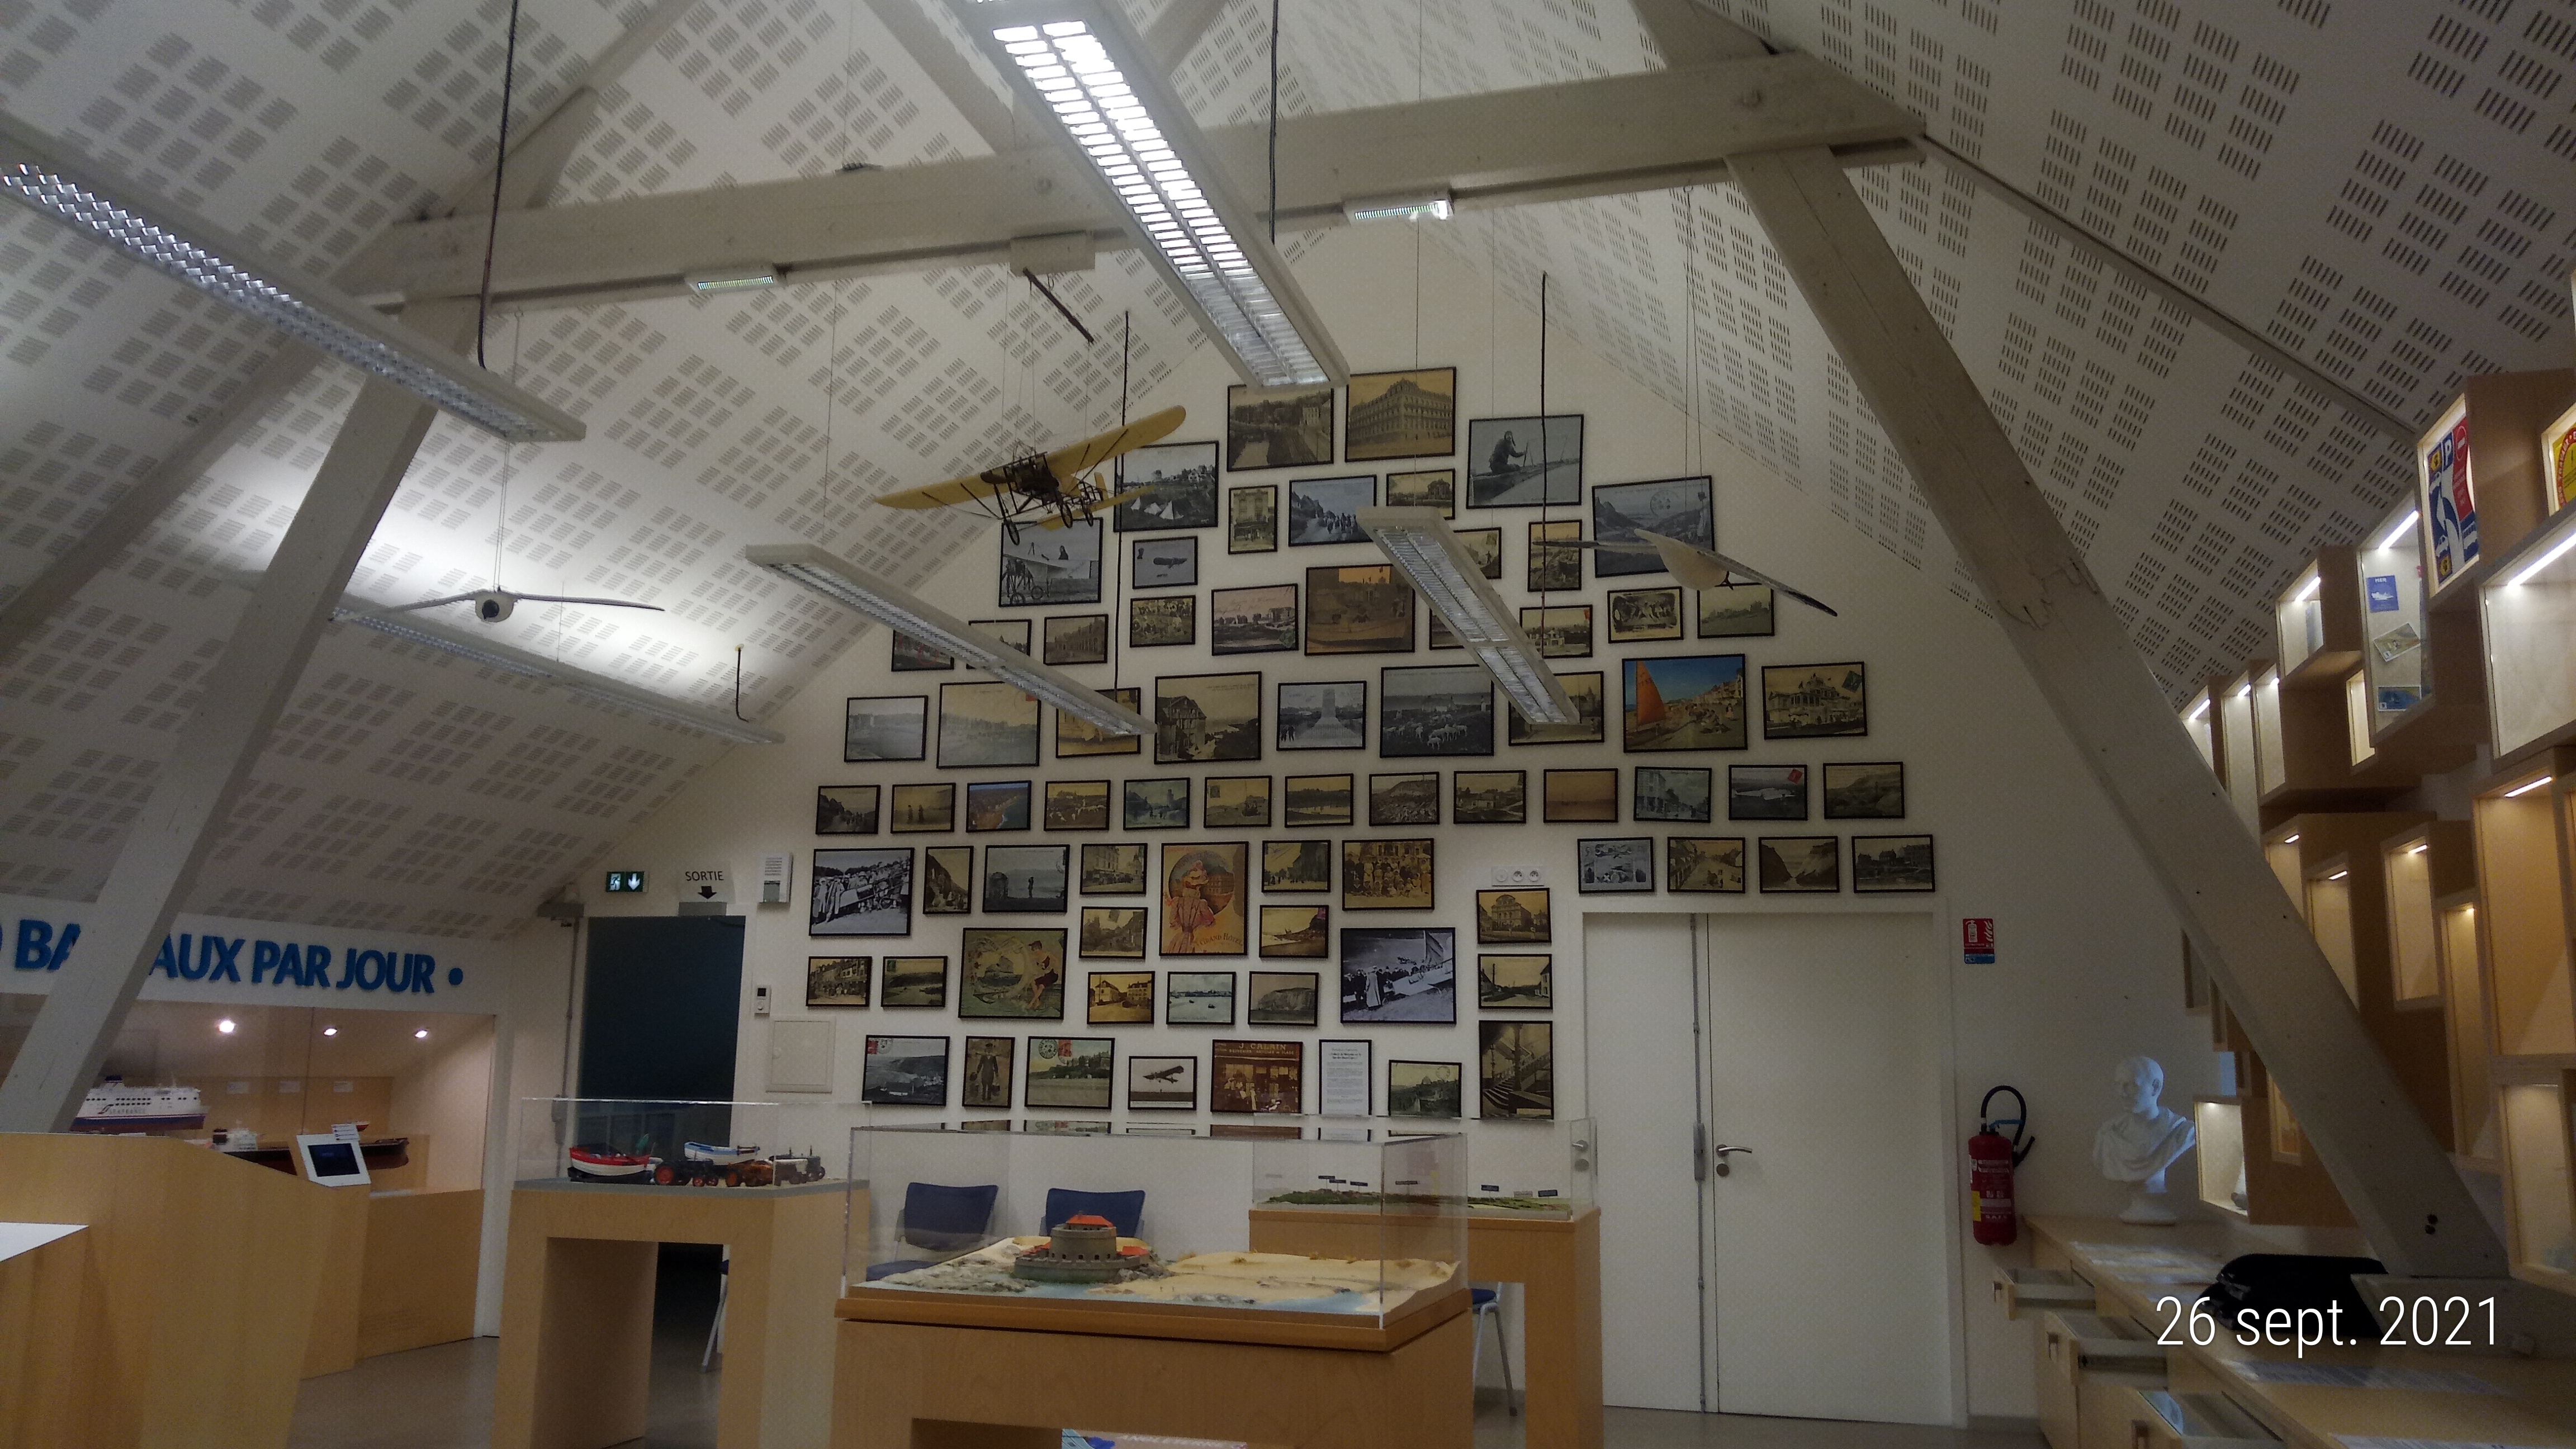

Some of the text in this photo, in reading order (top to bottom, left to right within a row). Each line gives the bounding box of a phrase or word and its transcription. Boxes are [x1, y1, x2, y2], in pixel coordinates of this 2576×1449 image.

[2445, 439, 2452, 466] P
[685, 870, 724, 882] SORTIE
[15, 918, 245, 982] BAAUX
[252, 940, 331, 988] PAR
[335, 947, 436, 993] JOUR
